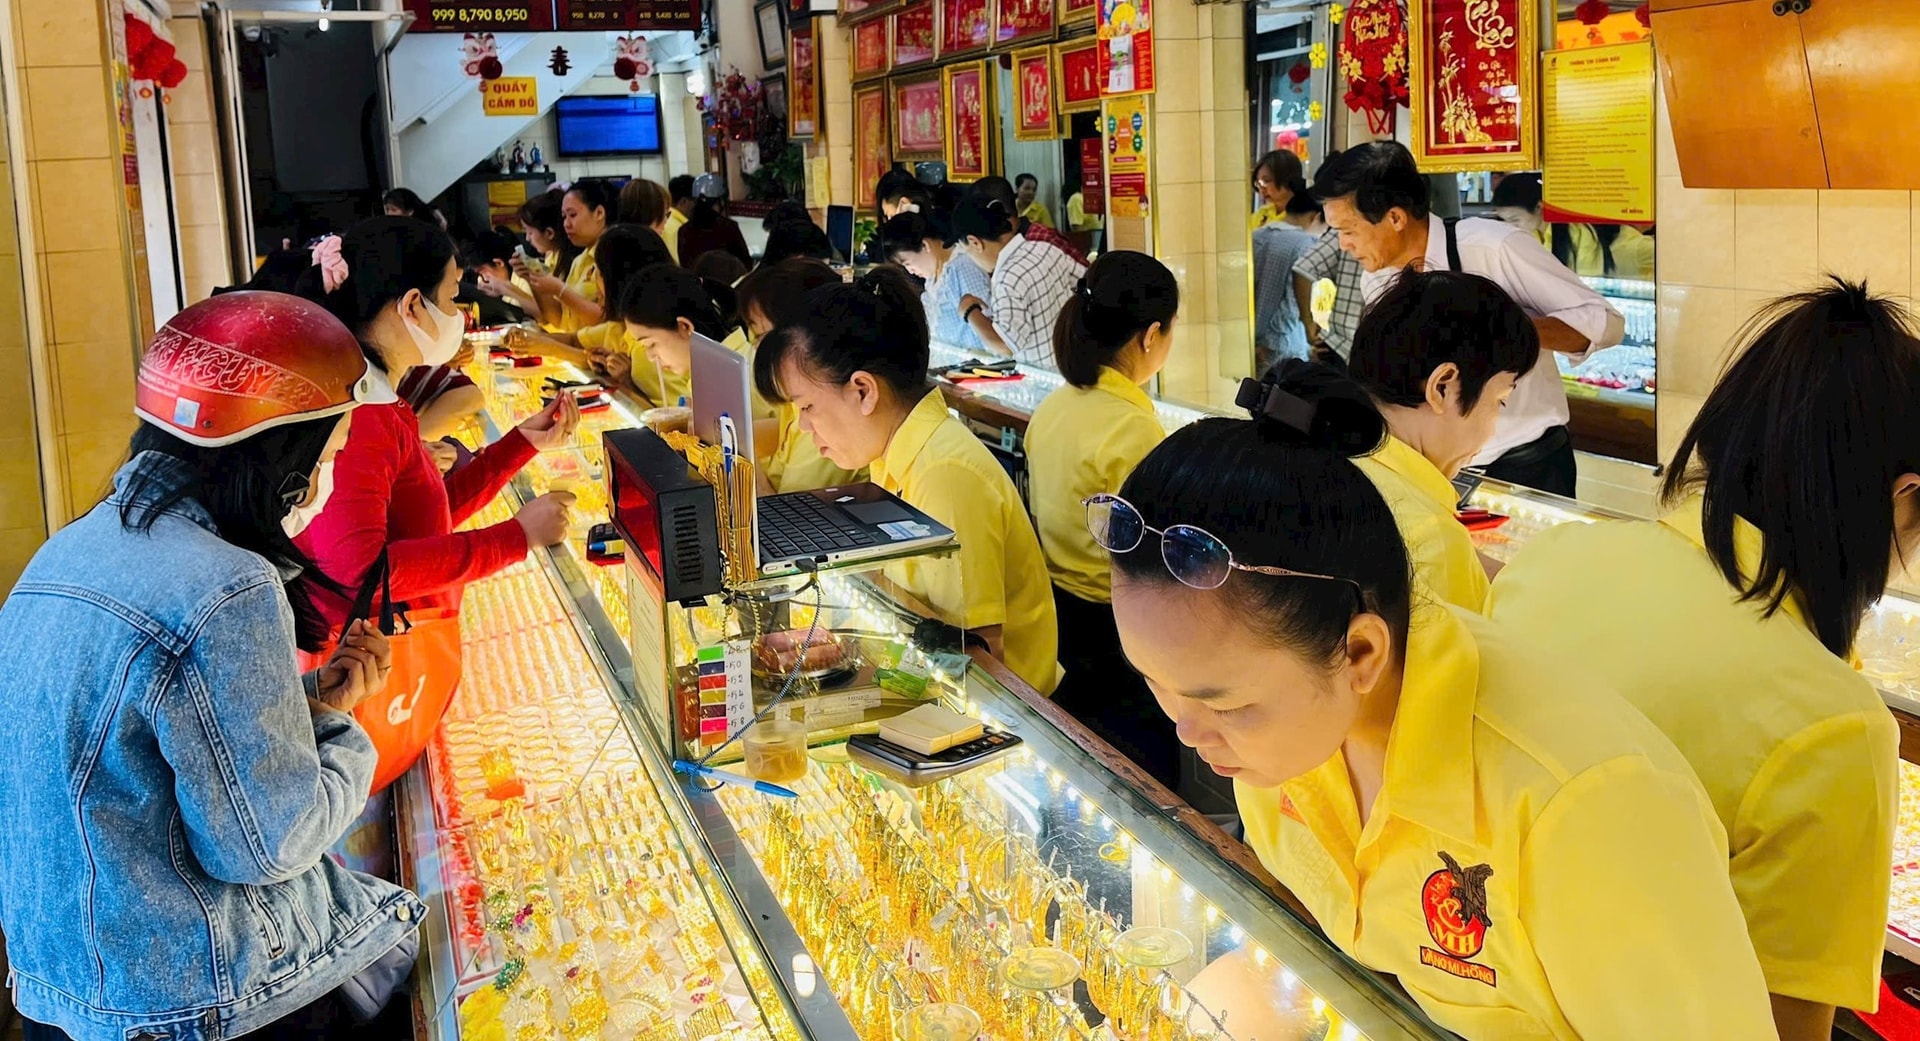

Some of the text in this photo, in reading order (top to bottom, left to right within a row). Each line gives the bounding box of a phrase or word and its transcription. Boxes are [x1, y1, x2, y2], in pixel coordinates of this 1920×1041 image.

[432, 8, 528, 23] 999 8,790 8,950
[1432, 919, 1476, 955] MH
